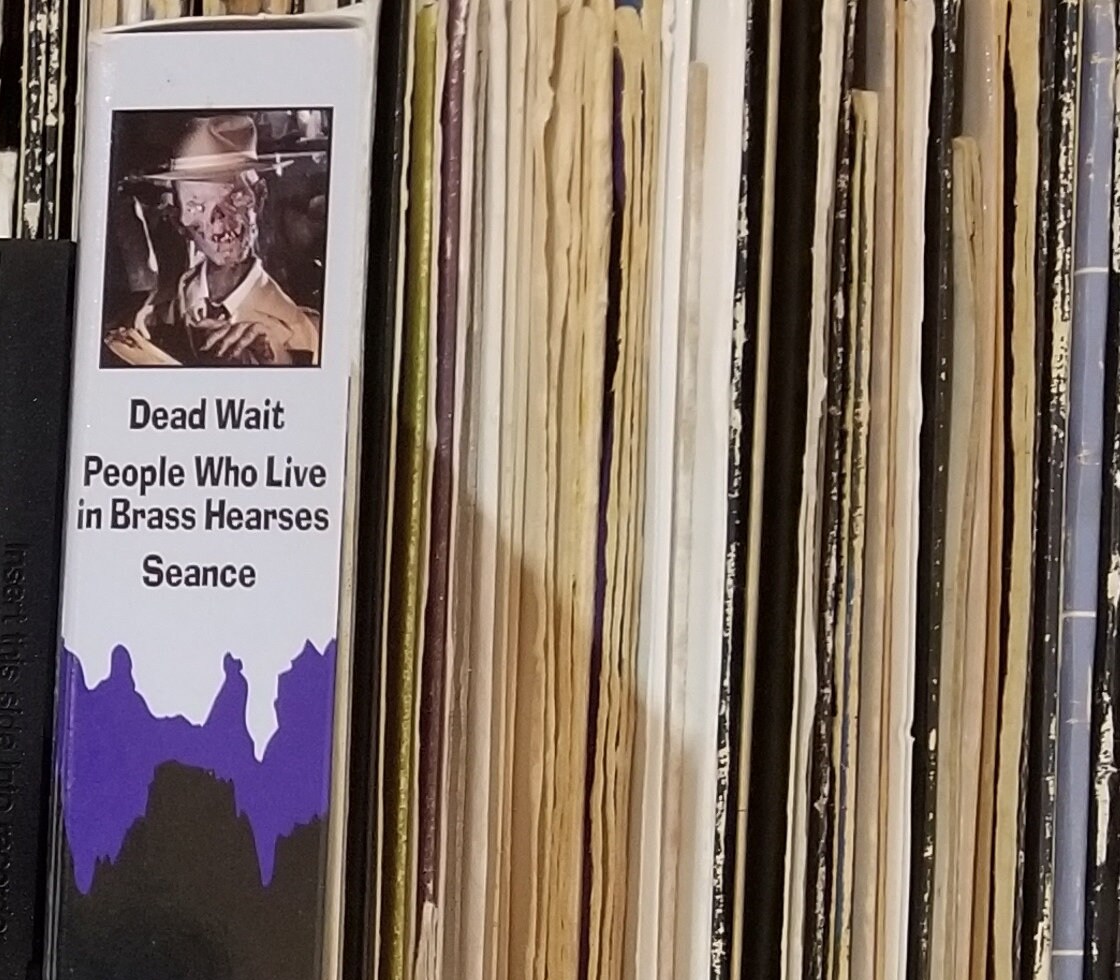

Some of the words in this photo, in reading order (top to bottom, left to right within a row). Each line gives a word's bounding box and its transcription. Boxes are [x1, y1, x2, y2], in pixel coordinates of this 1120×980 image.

[129, 398, 207, 430] Dead
[215, 398, 285, 430] Wait
[83, 455, 185, 496] People
[195, 455, 258, 487] Who
[266, 455, 327, 488] Live
[77, 498, 102, 530] in
[110, 498, 196, 530] Brass
[205, 498, 330, 531] Hearses
[0, 543, 32, 624] Insert
[142, 554, 257, 588] Seance
